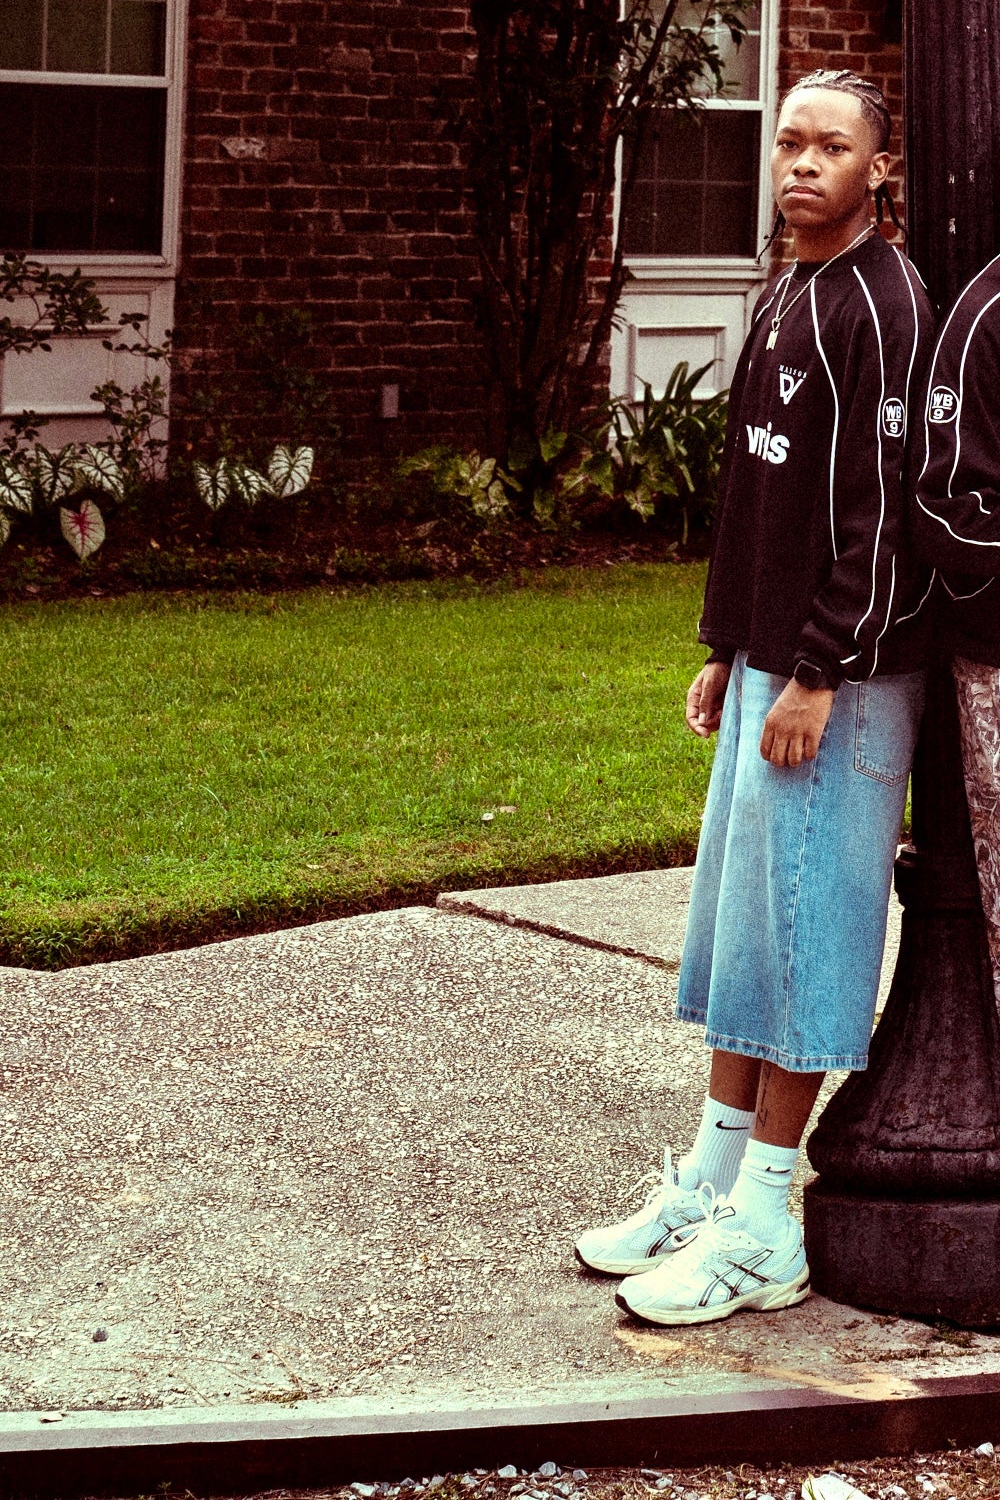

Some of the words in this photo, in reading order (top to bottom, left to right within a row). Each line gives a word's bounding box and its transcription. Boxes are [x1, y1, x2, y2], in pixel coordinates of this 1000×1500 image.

[932, 393, 953, 408] WB
[885, 404, 902, 420] WB
[932, 408, 944, 420] 9
[889, 421, 898, 434] 9
